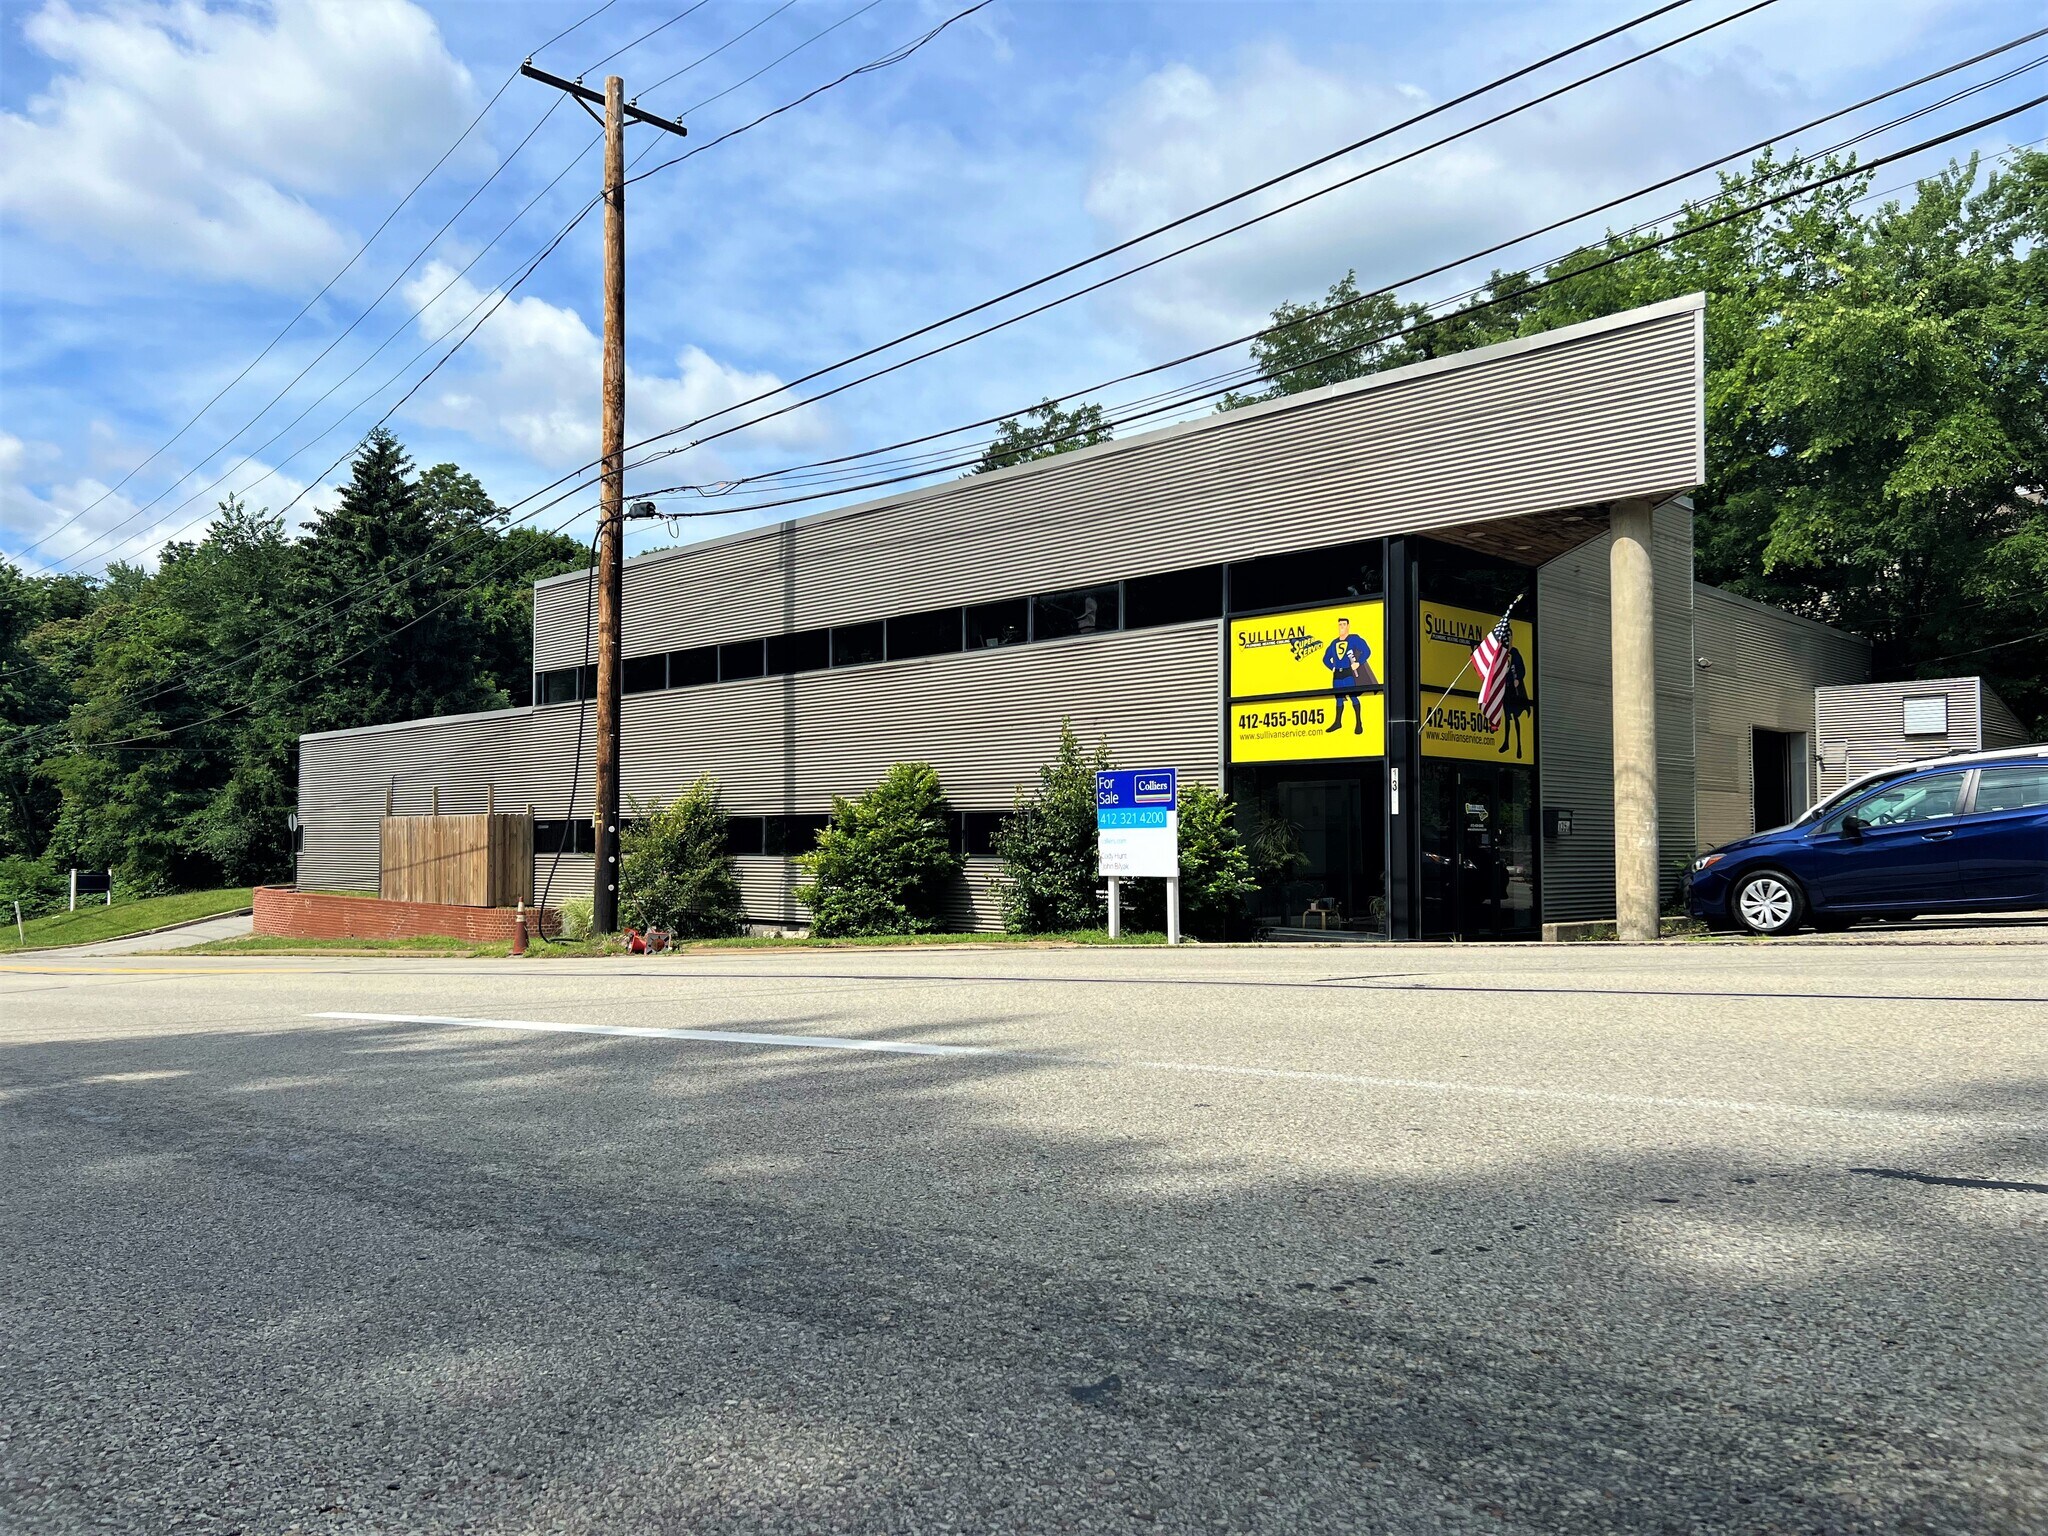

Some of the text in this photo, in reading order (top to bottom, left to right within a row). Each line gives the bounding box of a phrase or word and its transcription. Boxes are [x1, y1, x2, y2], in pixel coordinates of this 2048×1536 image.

[1426, 614, 1483, 640] SULLIVAN
[1238, 626, 1305, 646] SULLIVAN
[1238, 708, 1325, 730] 412-455-5045
[1239, 728, 1324, 741] www.sullivanservice.com
[1425, 731, 1496, 746] www.sullivanservice.com
[1098, 777, 1115, 790] For
[1138, 780, 1168, 791] Colliers
[1098, 791, 1119, 805] Sale
[1100, 811, 1164, 825] 412 321 4200
